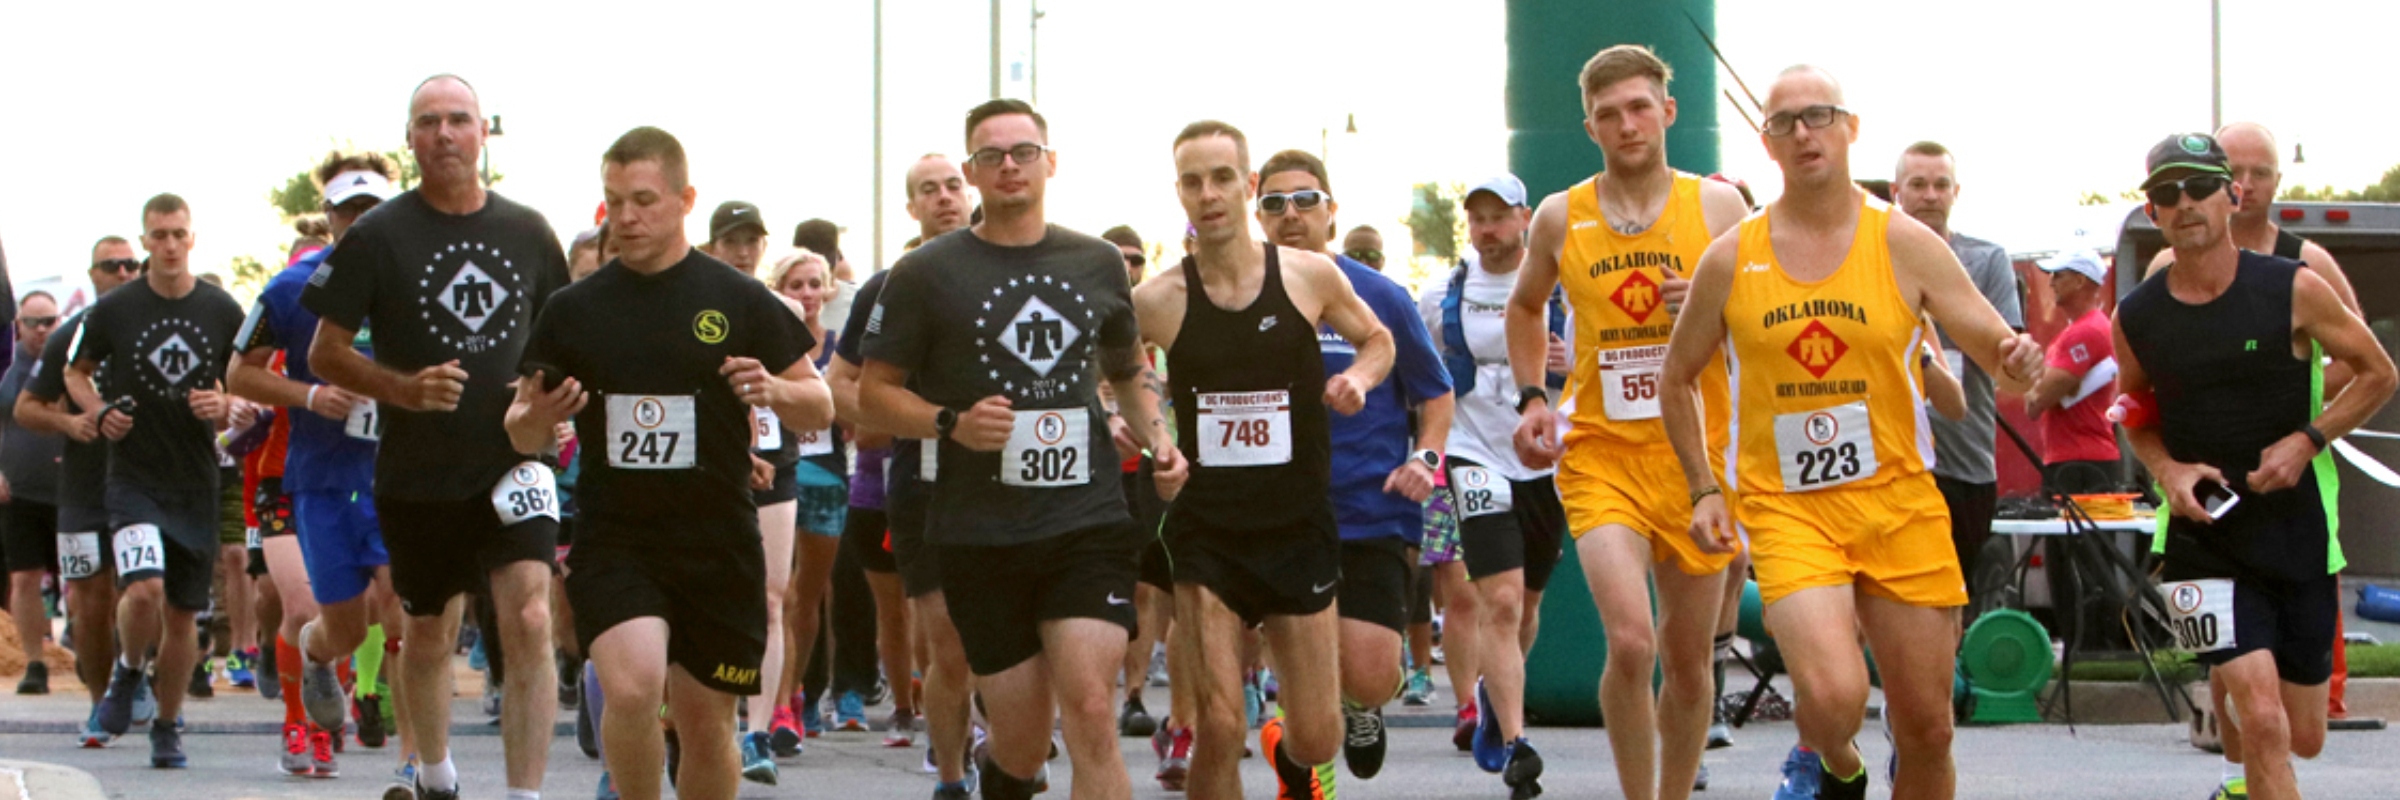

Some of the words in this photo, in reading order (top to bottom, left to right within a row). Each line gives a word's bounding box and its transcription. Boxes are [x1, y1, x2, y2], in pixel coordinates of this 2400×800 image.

[1589, 251, 1684, 279] OKLAHOMA
[1763, 299, 1868, 329] OKLAHOMA
[1620, 345, 1668, 360] PRODUCT
[1622, 372, 1660, 402] 55
[1798, 380, 1839, 396] NATIONAL
[621, 431, 680, 464] 247
[1218, 419, 1270, 448] 748
[1021, 446, 1078, 483] 302
[1796, 441, 1860, 486] 223
[507, 487, 556, 517] 362
[1464, 488, 1493, 512] 82
[61, 555, 91, 575] 125
[121, 545, 157, 569] 174
[2172, 612, 2218, 650] 300
[712, 663, 758, 685] ARMY
